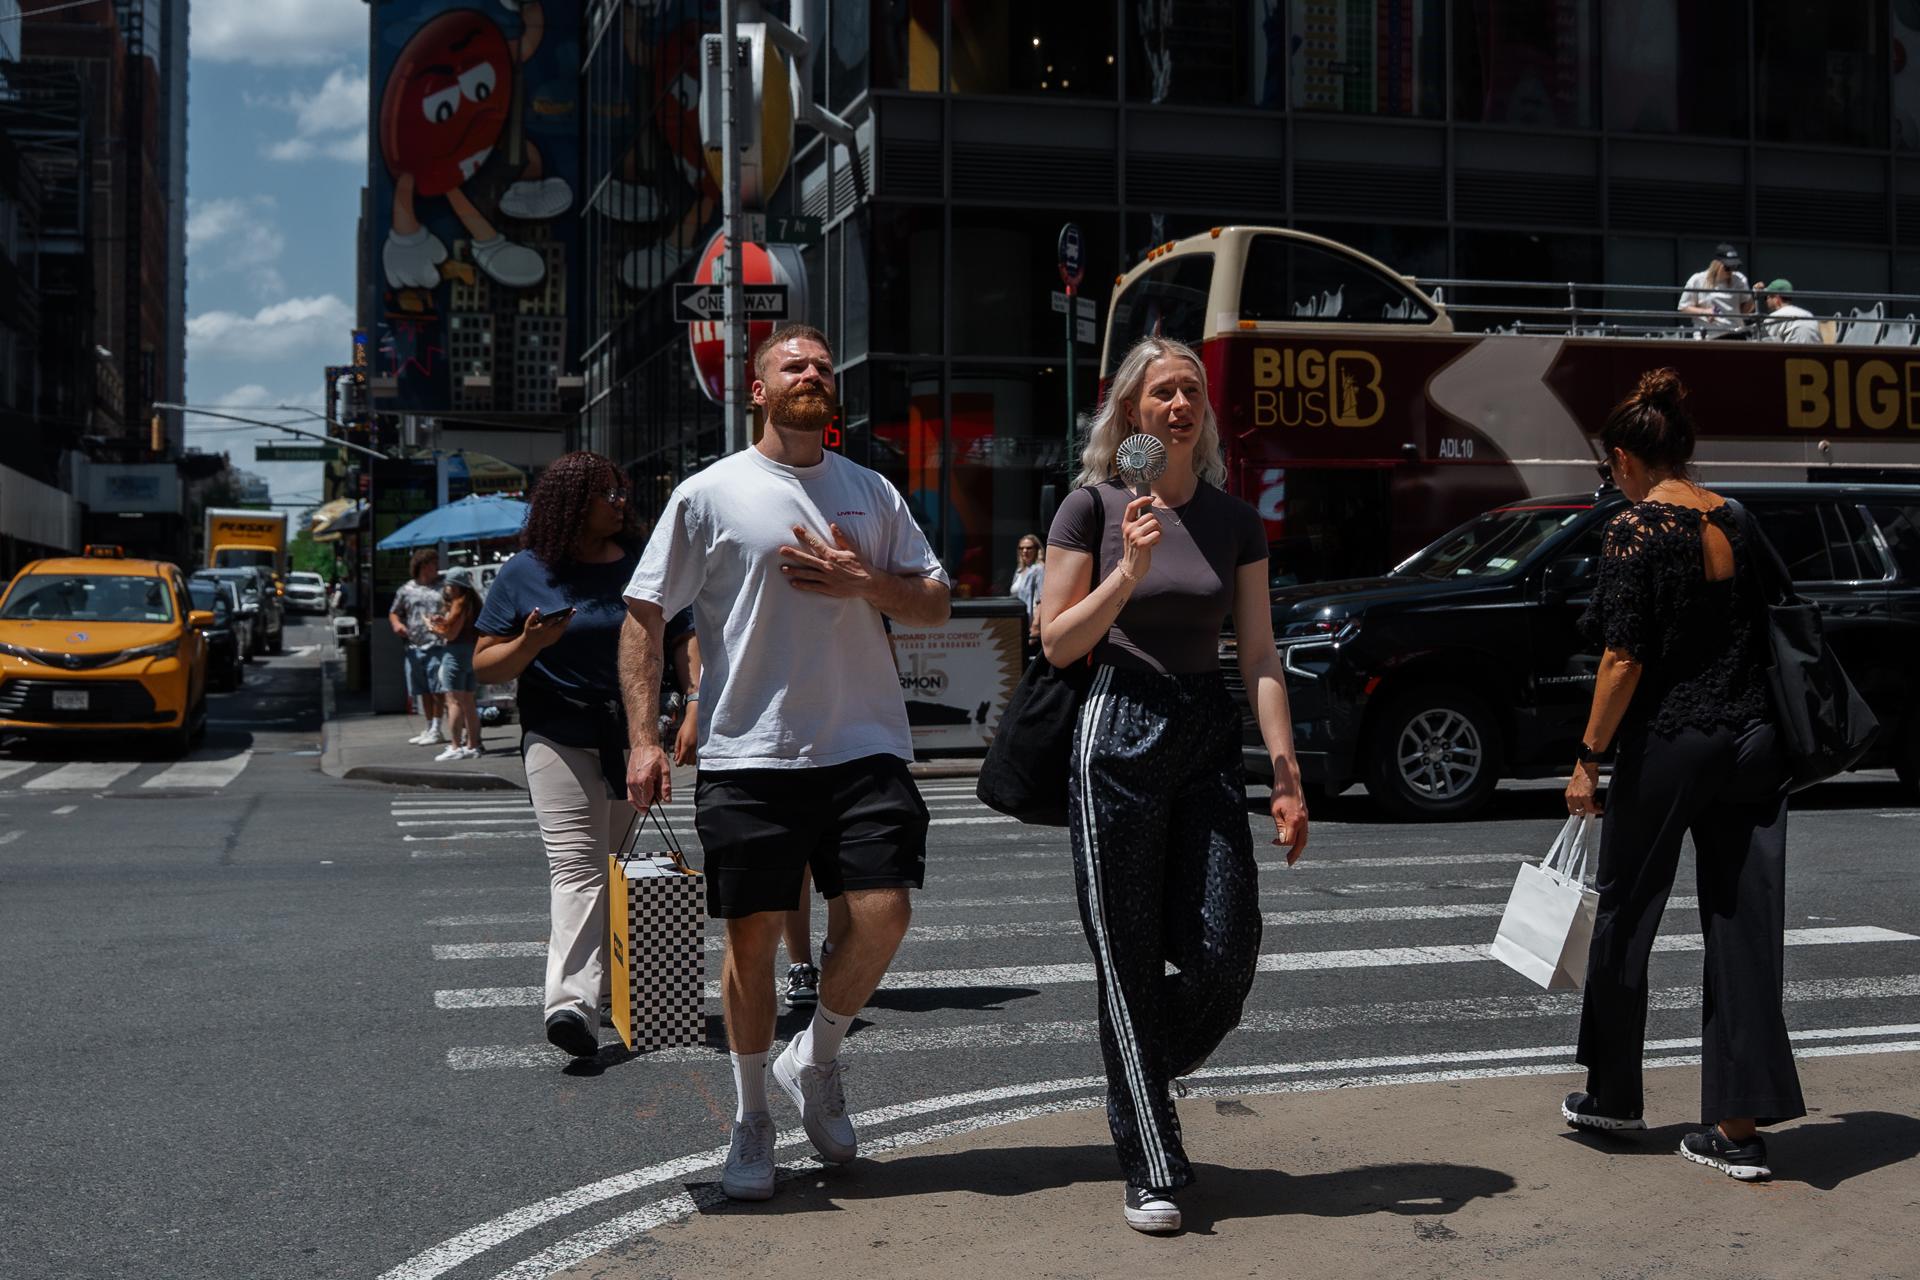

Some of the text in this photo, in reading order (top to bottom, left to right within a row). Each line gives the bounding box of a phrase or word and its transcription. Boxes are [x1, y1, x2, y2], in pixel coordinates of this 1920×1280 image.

[779, 218, 788, 240] 7
[743, 295, 776, 309] WAY
[1252, 346, 1327, 389] BIG
[1254, 389, 1328, 427] BUS
[1438, 438, 1474, 459] ADL10
